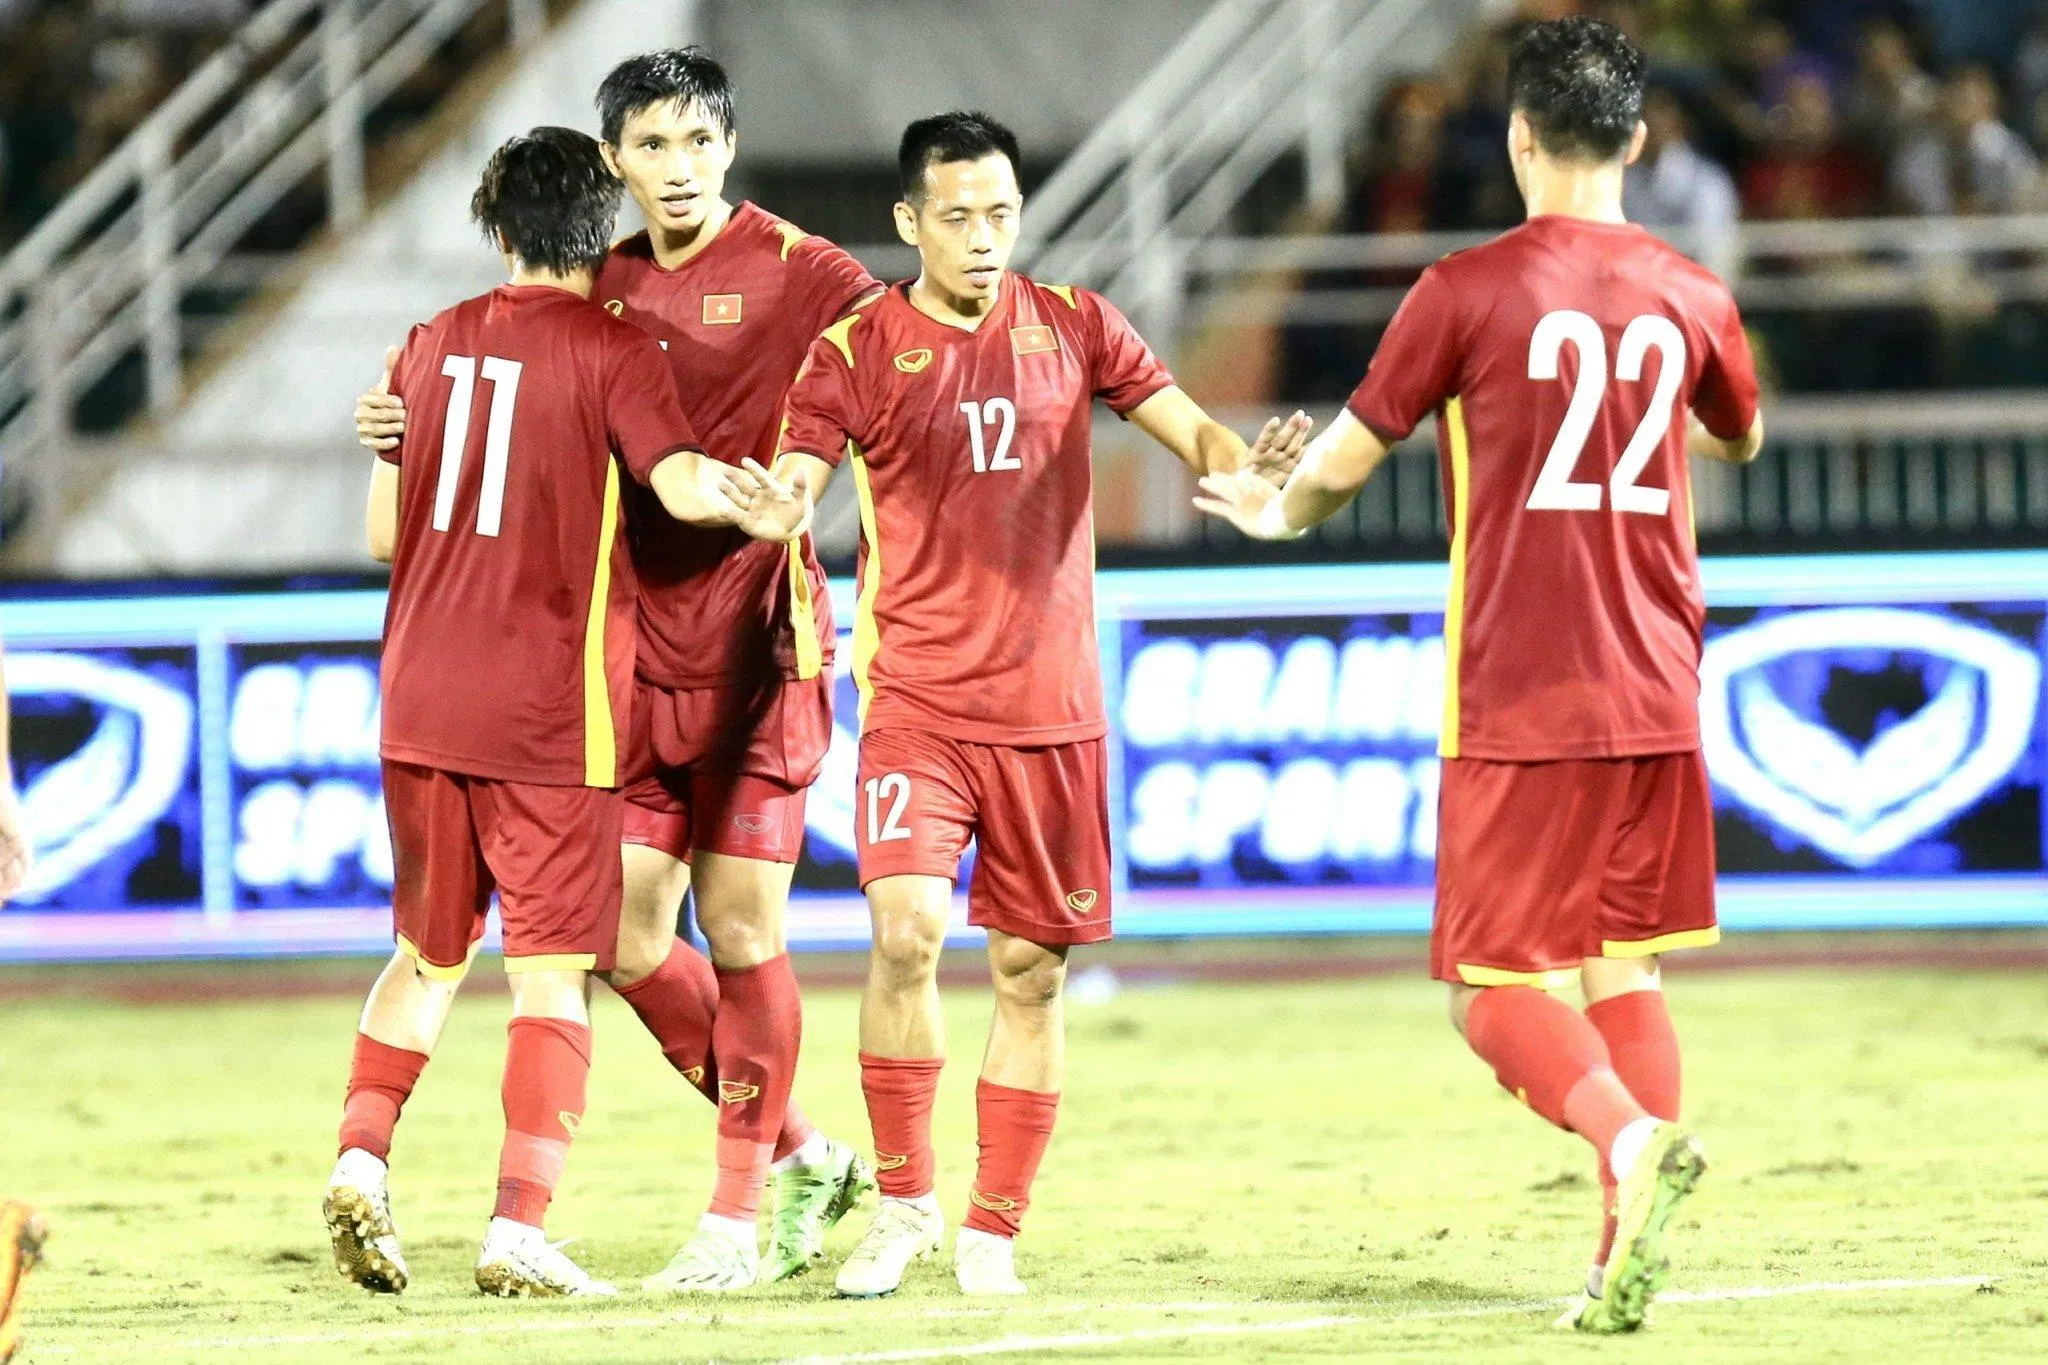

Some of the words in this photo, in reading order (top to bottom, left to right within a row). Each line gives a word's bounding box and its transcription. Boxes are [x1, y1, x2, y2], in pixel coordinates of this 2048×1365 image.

[432, 353, 524, 538] 11
[959, 396, 1023, 473] 12
[1525, 309, 1687, 516] 22
[863, 772, 913, 845] 12
